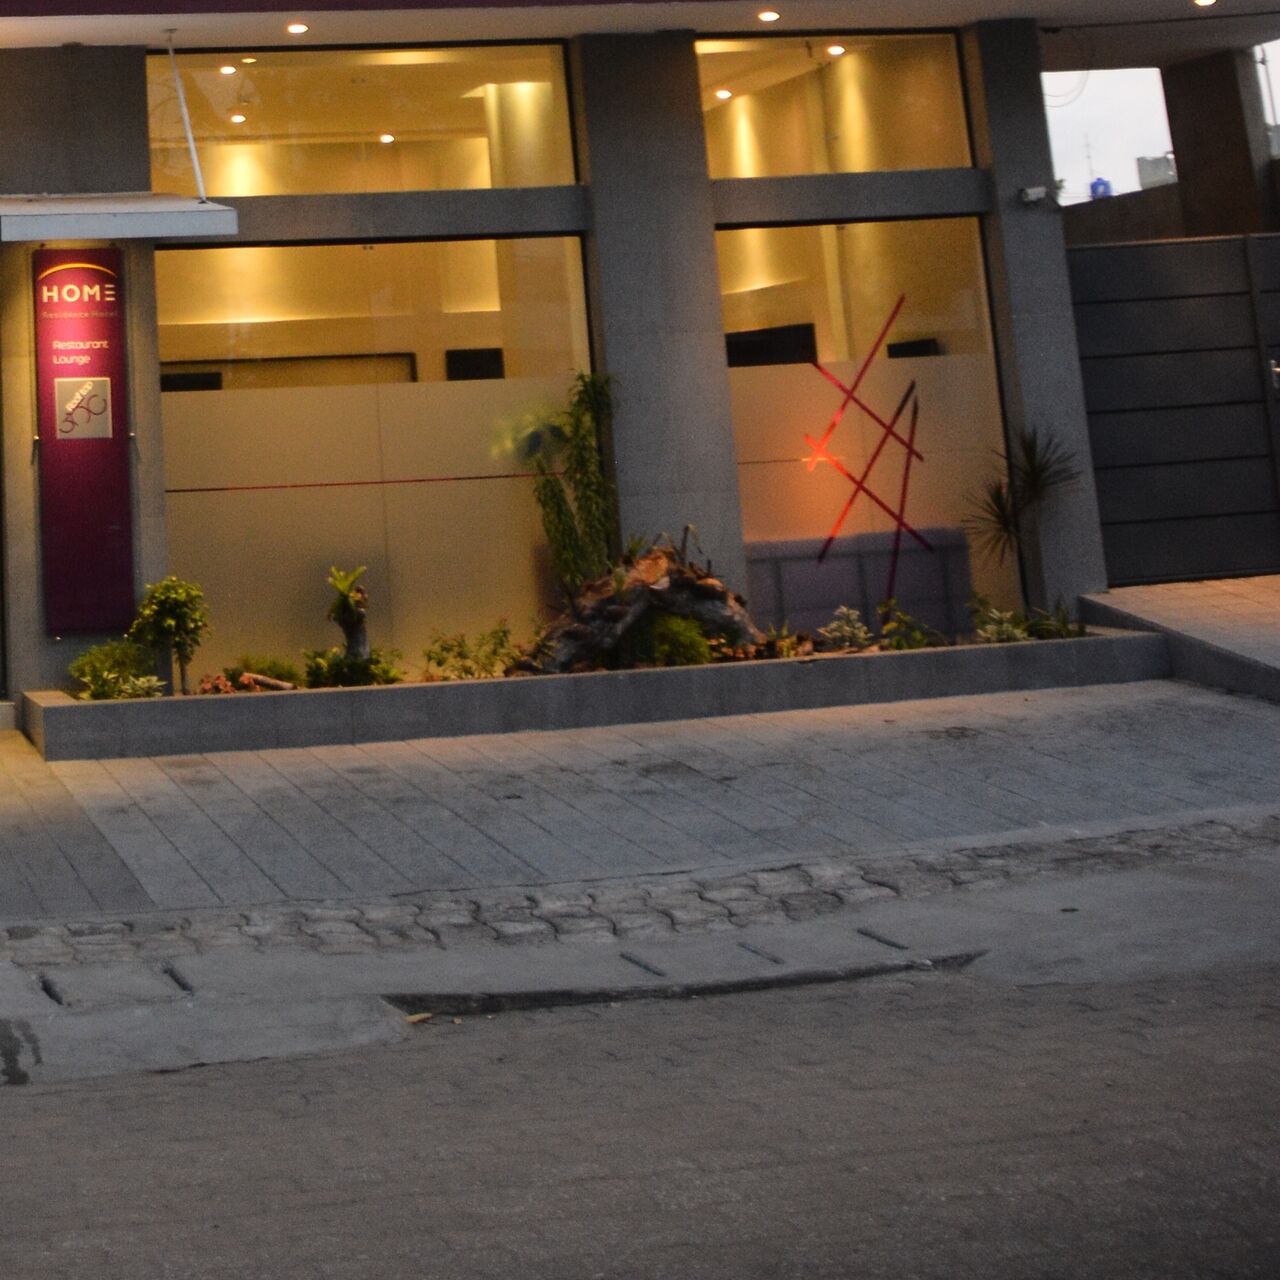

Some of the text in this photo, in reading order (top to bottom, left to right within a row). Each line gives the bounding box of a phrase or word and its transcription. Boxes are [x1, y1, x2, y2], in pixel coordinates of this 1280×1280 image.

[42, 283, 116, 303] HOME
[52, 340, 109, 350] Restaurant
[52, 354, 91, 366] Lounge
